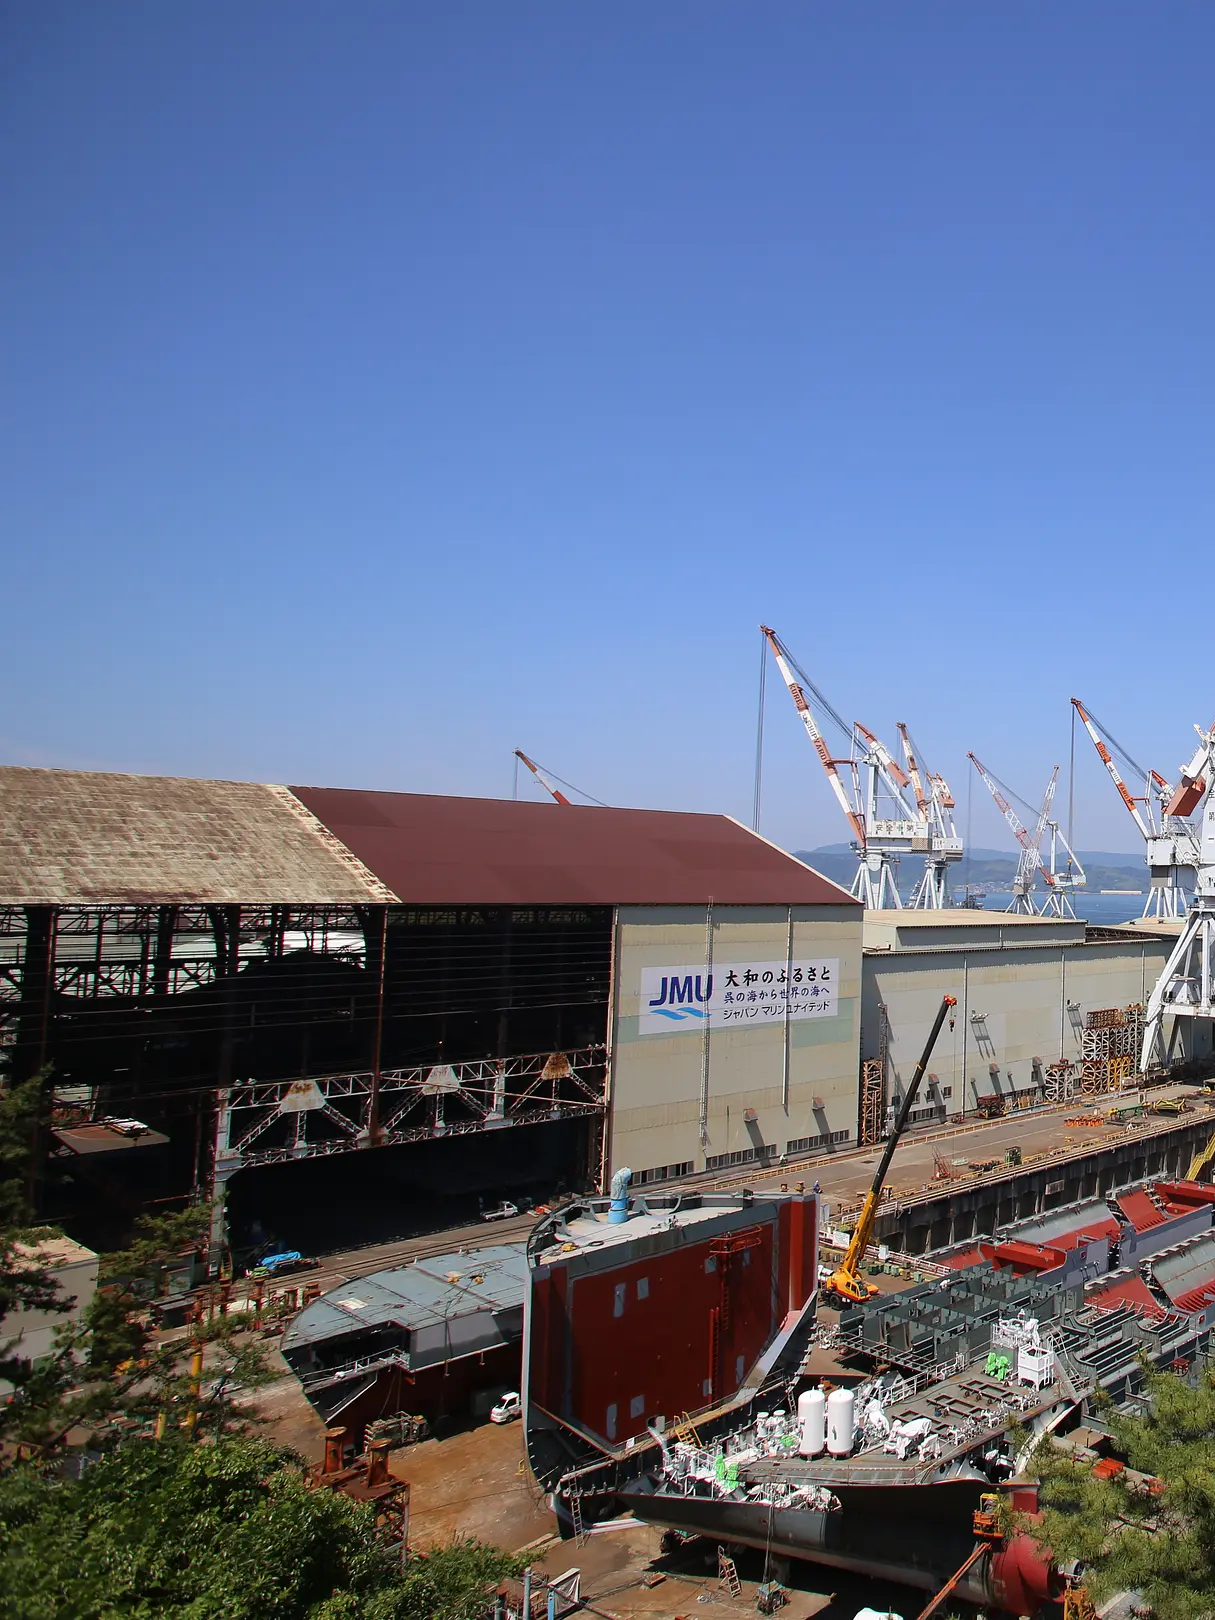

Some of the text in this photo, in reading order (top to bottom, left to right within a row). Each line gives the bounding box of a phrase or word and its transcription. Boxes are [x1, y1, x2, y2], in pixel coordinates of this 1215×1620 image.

[788, 683, 803, 706] KURE
[725, 966, 830, 988] 大和のふるさと
[649, 975, 713, 1006] JMU
[724, 985, 830, 1004] 呉の海から世界の海へ
[723, 1007, 759, 1020] ジャパン
